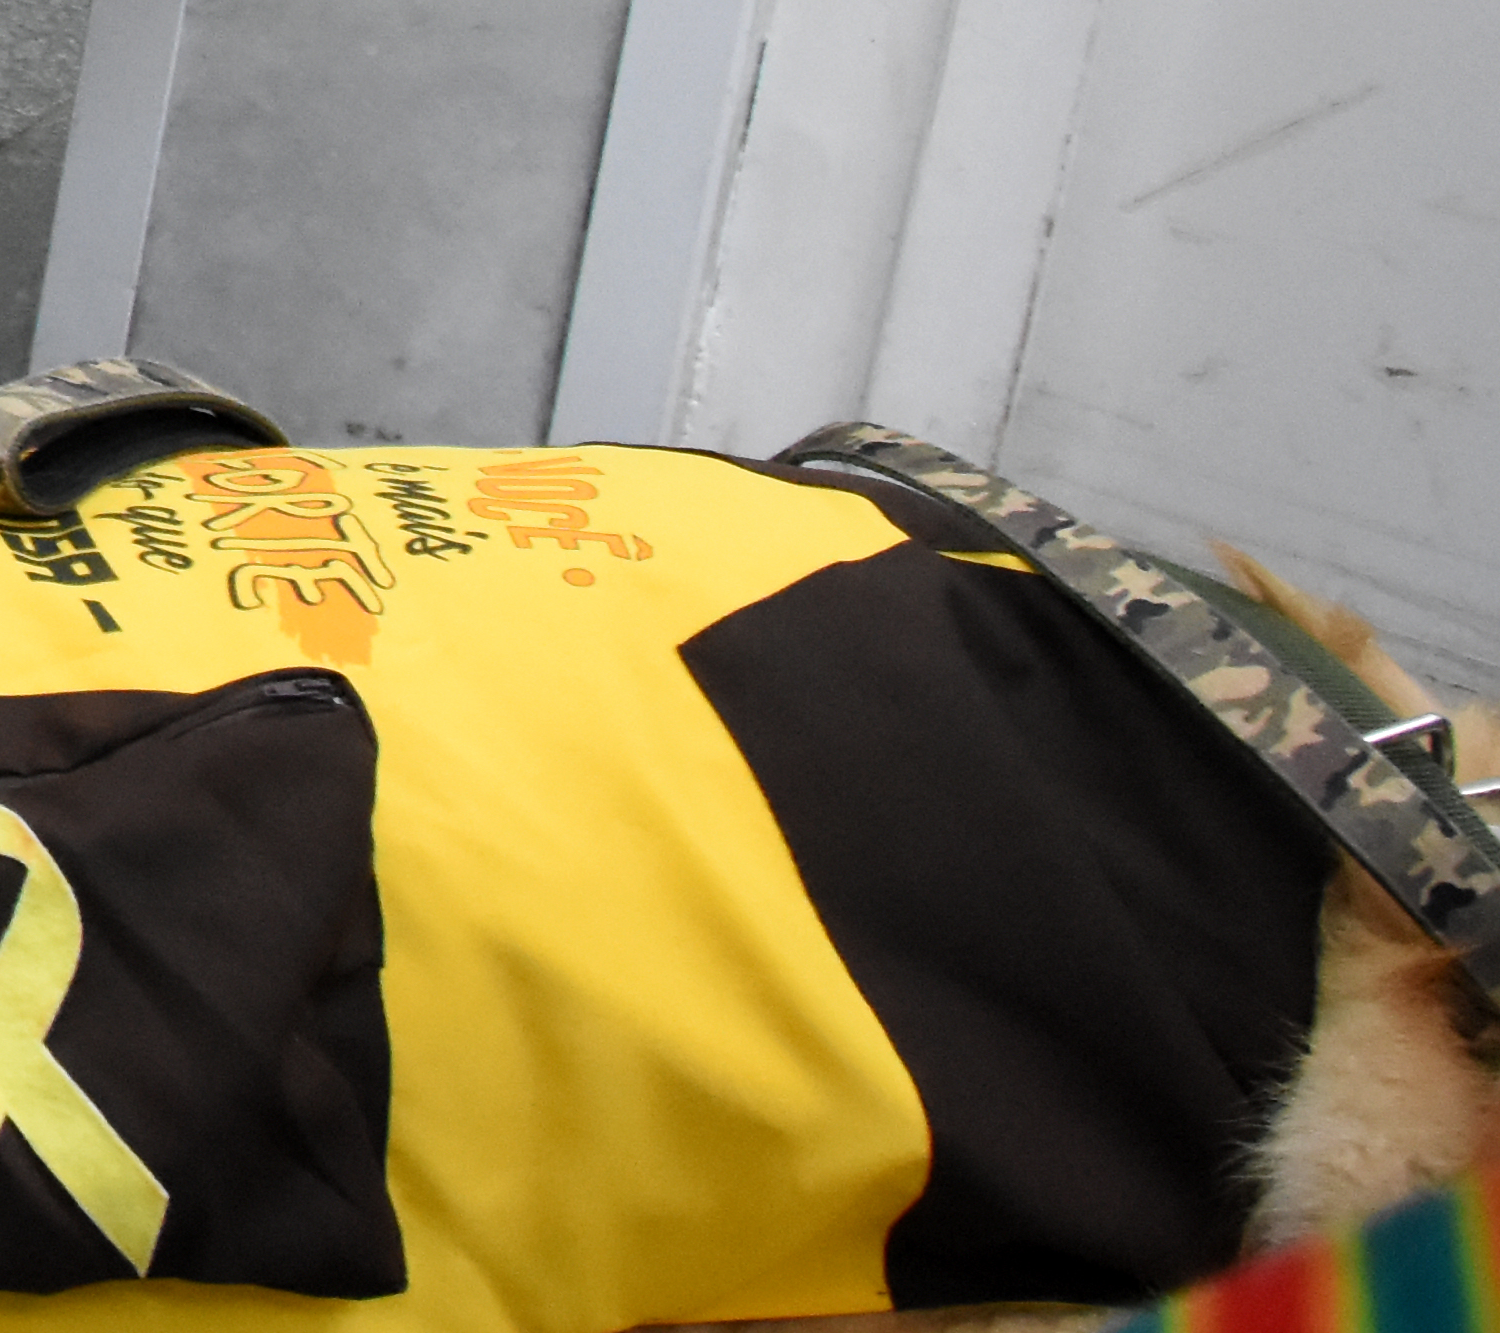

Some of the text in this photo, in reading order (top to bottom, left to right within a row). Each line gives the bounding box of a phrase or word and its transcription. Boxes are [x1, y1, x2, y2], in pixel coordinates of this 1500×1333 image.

[91, 505, 194, 575] que
[373, 478, 490, 562] mais
[467, 455, 654, 561] VOCÊ
